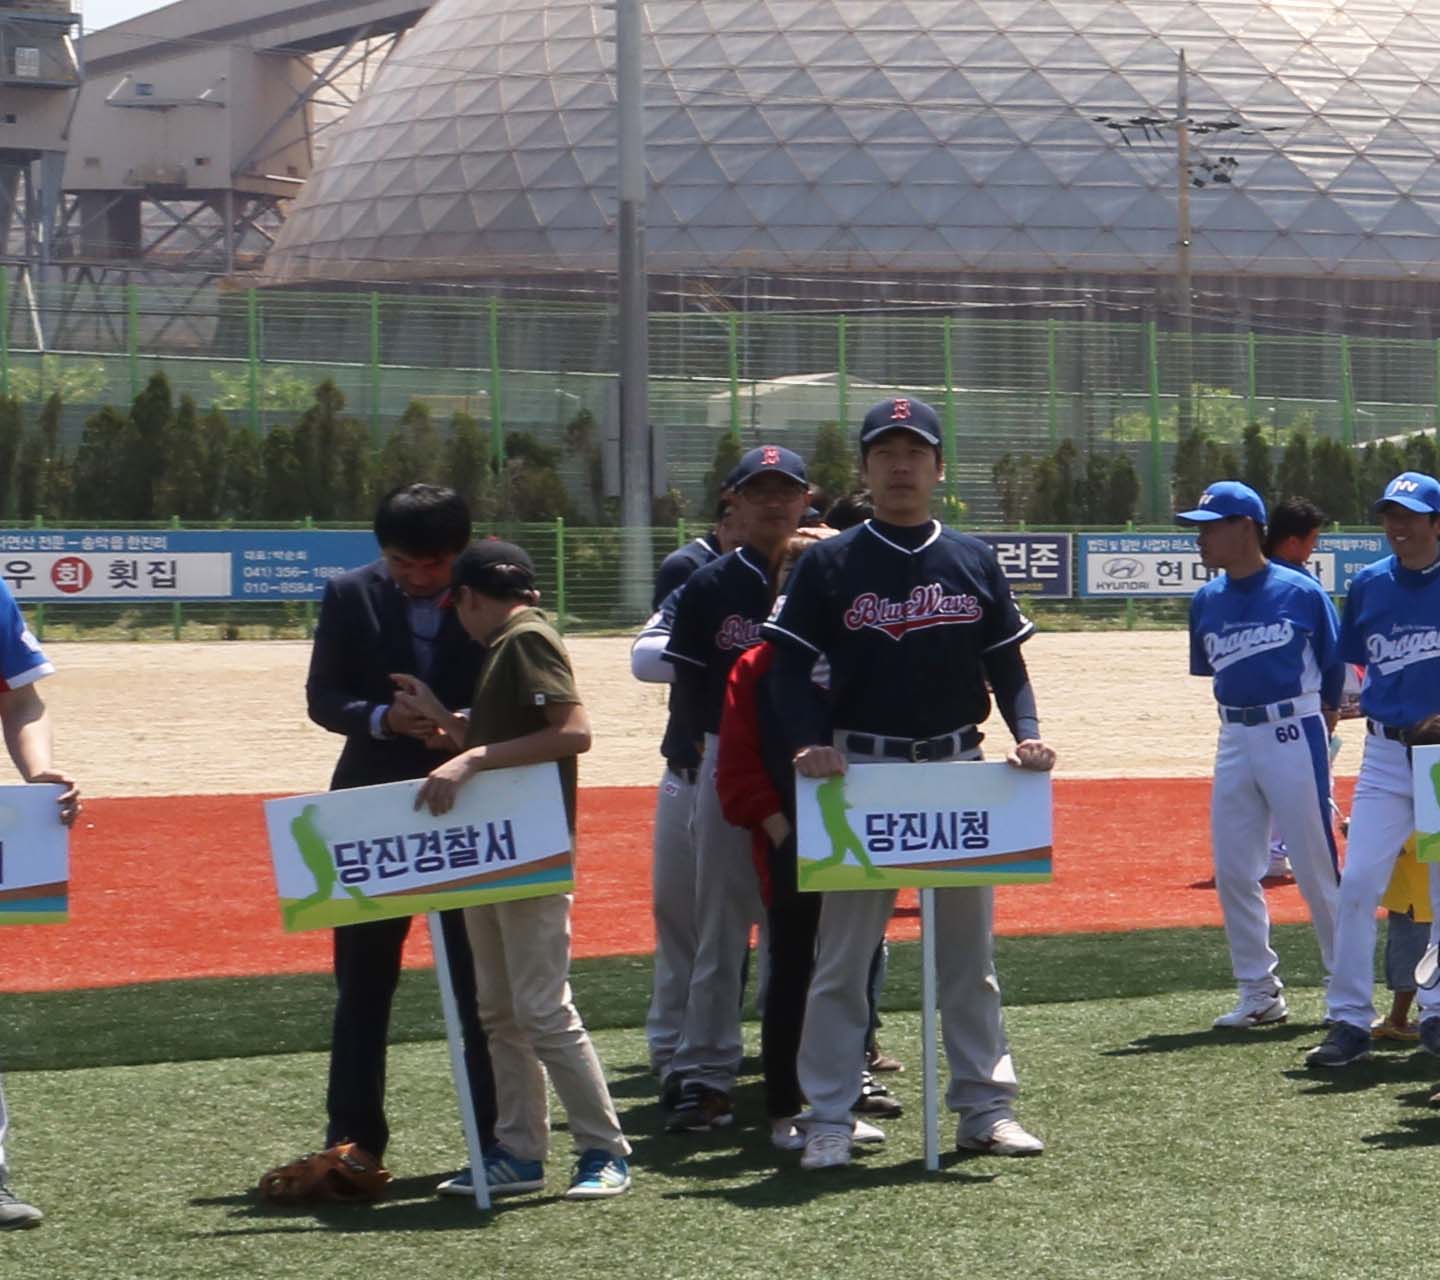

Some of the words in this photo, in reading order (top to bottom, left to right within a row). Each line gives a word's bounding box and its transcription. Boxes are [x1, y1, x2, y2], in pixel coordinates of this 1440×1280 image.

[108, 560, 177, 589] 횟집
[1096, 581, 1149, 591] HYUNDAI
[844, 582, 984, 633] BlueWave
[1203, 619, 1295, 665] Dragons
[1275, 724, 1300, 743] 60
[333, 819, 518, 885] 당진경찰서
[865, 810, 990, 852] 당진시청
